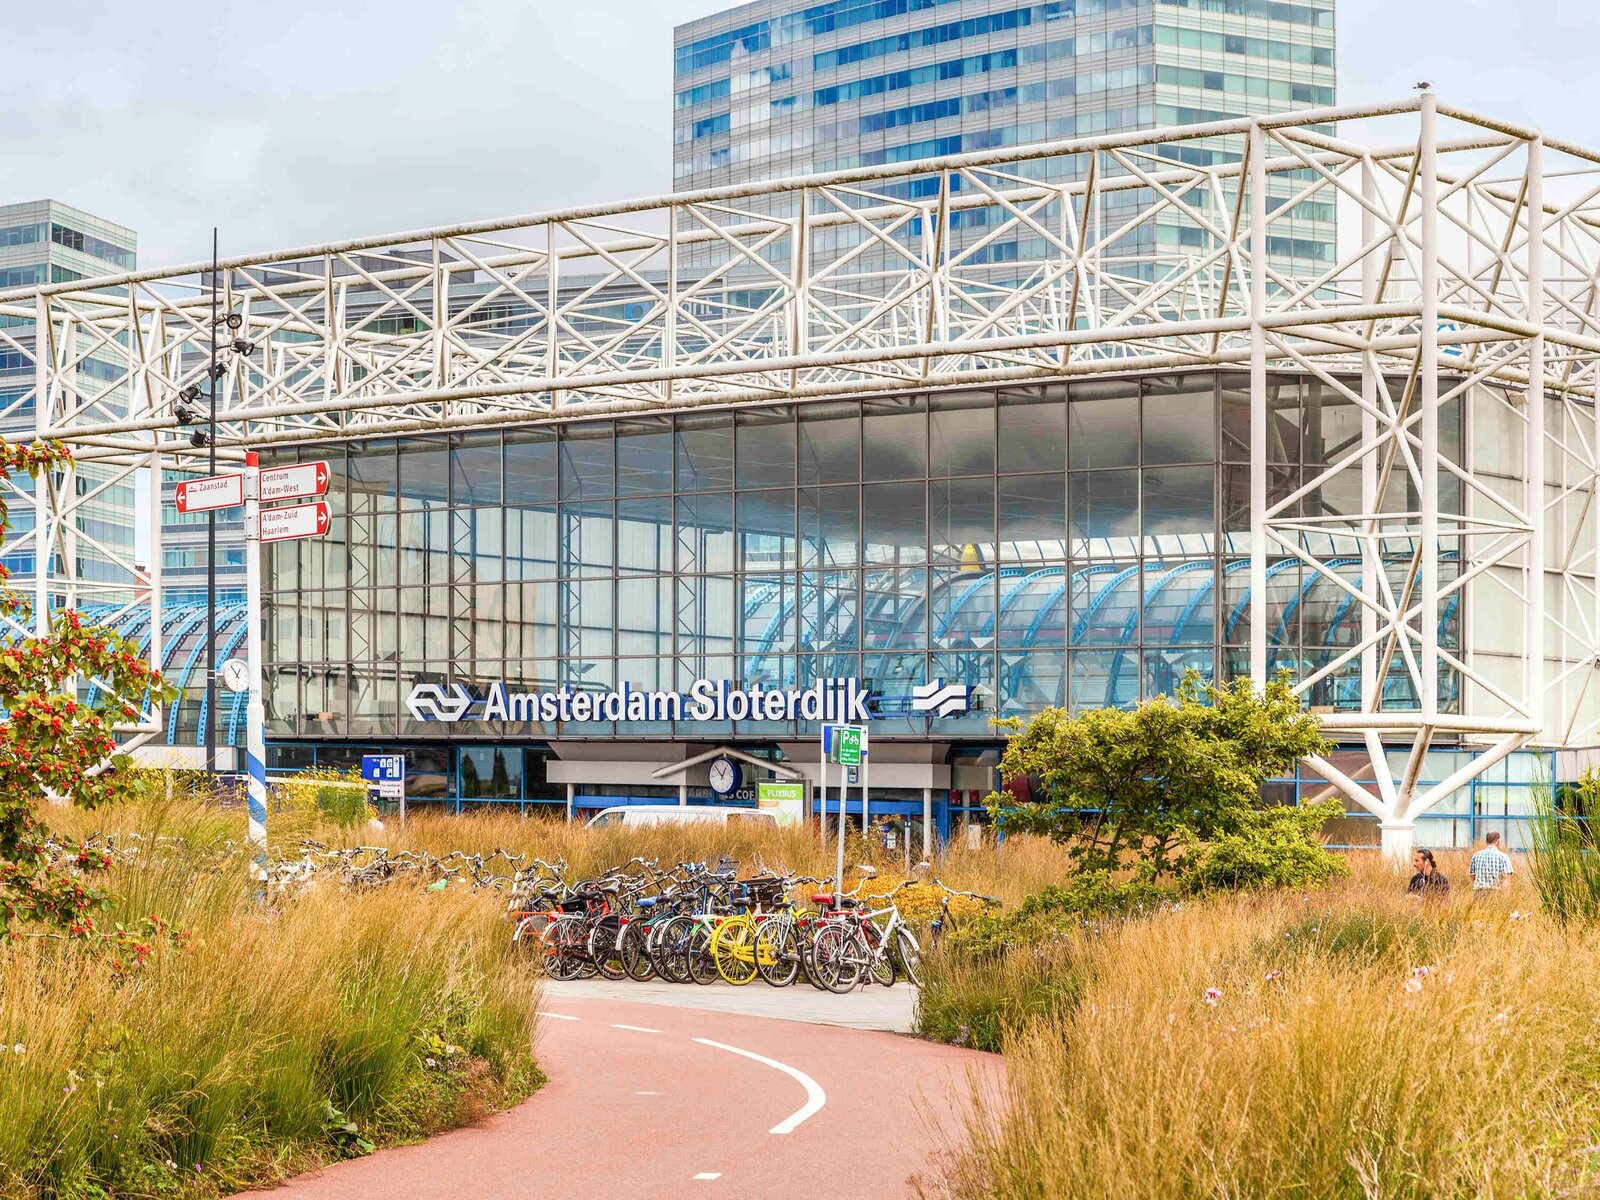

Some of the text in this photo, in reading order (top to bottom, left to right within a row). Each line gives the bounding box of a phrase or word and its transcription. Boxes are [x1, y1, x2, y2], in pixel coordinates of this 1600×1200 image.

[262, 472, 289, 483] Centrum
[199, 480, 228, 492] Zaanstad
[262, 483, 300, 496] A'dam-West
[262, 510, 299, 523] A'dam-Zuid
[262, 526, 289, 536] Haarlem
[483, 677, 872, 723] Amsterdam Sloterdijk
[767, 789, 796, 798] FLIXBUS
